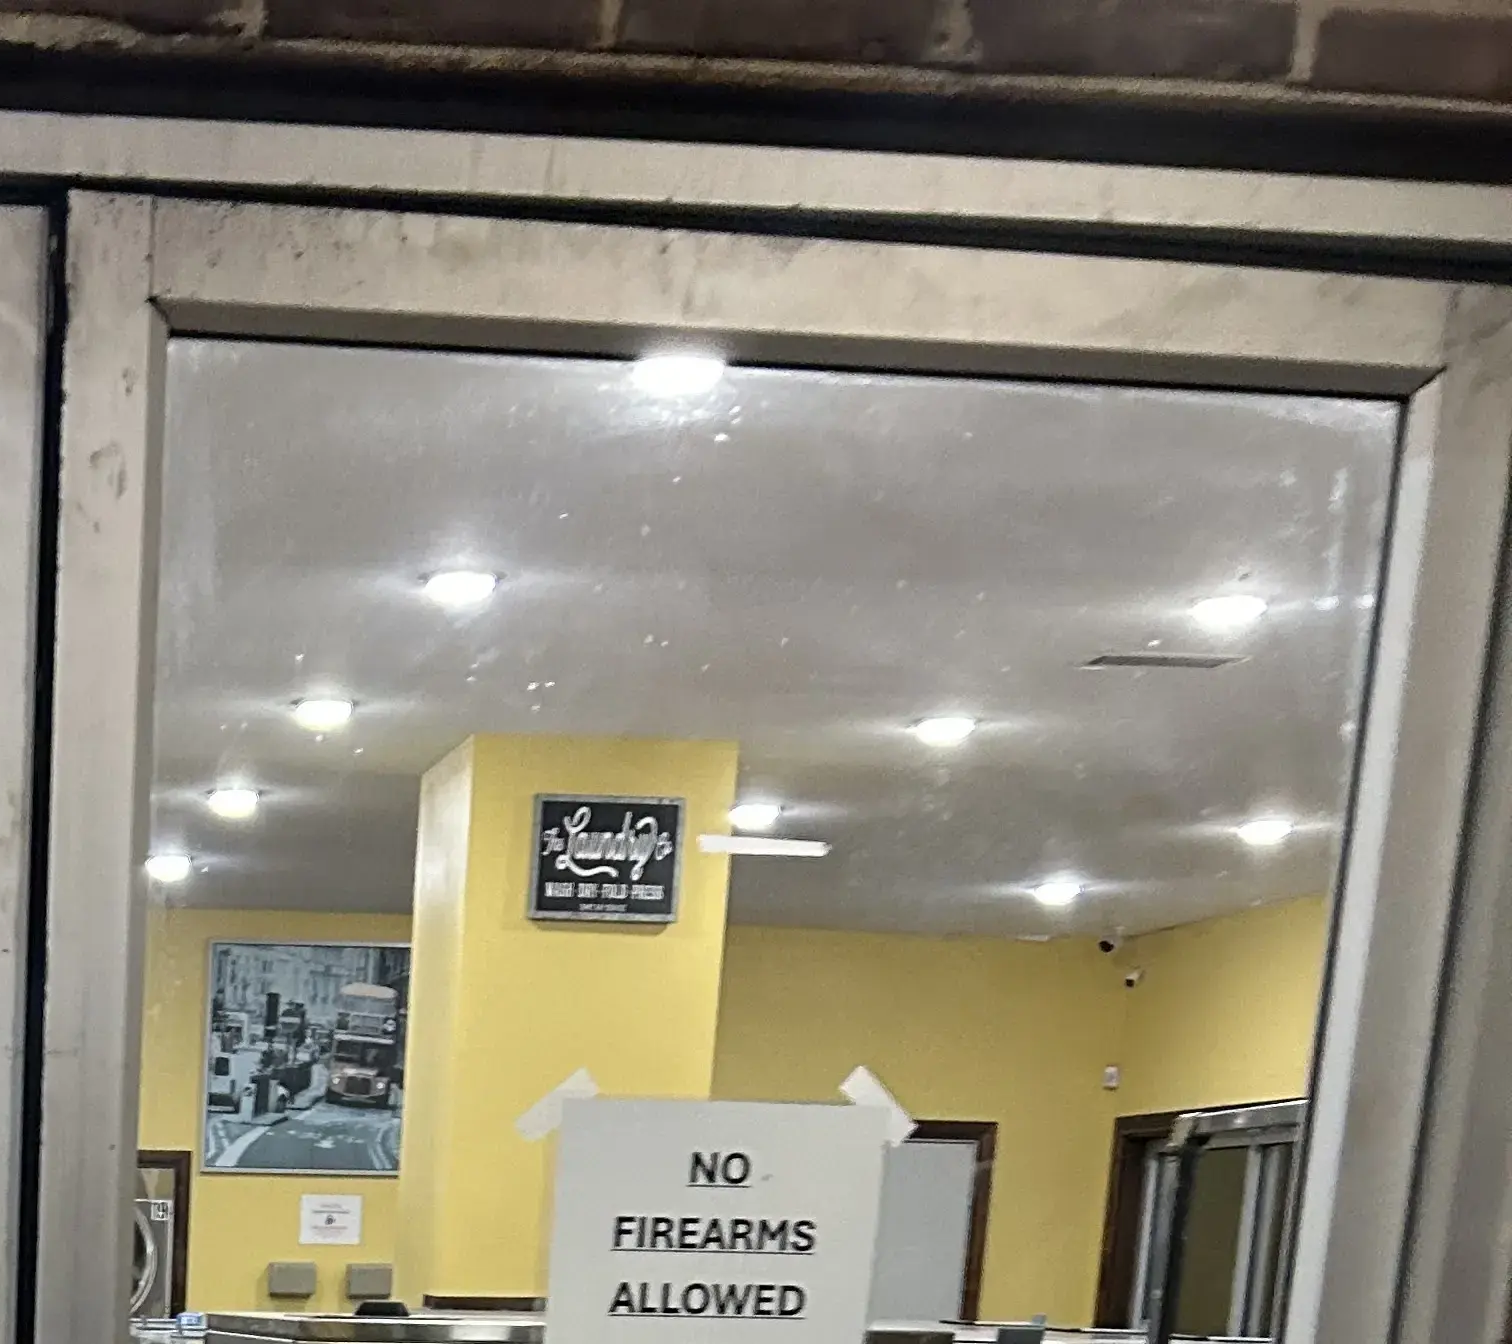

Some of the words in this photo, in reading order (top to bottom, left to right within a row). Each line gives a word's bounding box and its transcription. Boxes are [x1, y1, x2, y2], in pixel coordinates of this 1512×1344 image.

[688, 1152, 752, 1185] NO
[612, 1216, 818, 1252] FIREARMS
[608, 1282, 808, 1317] ALLOWED
